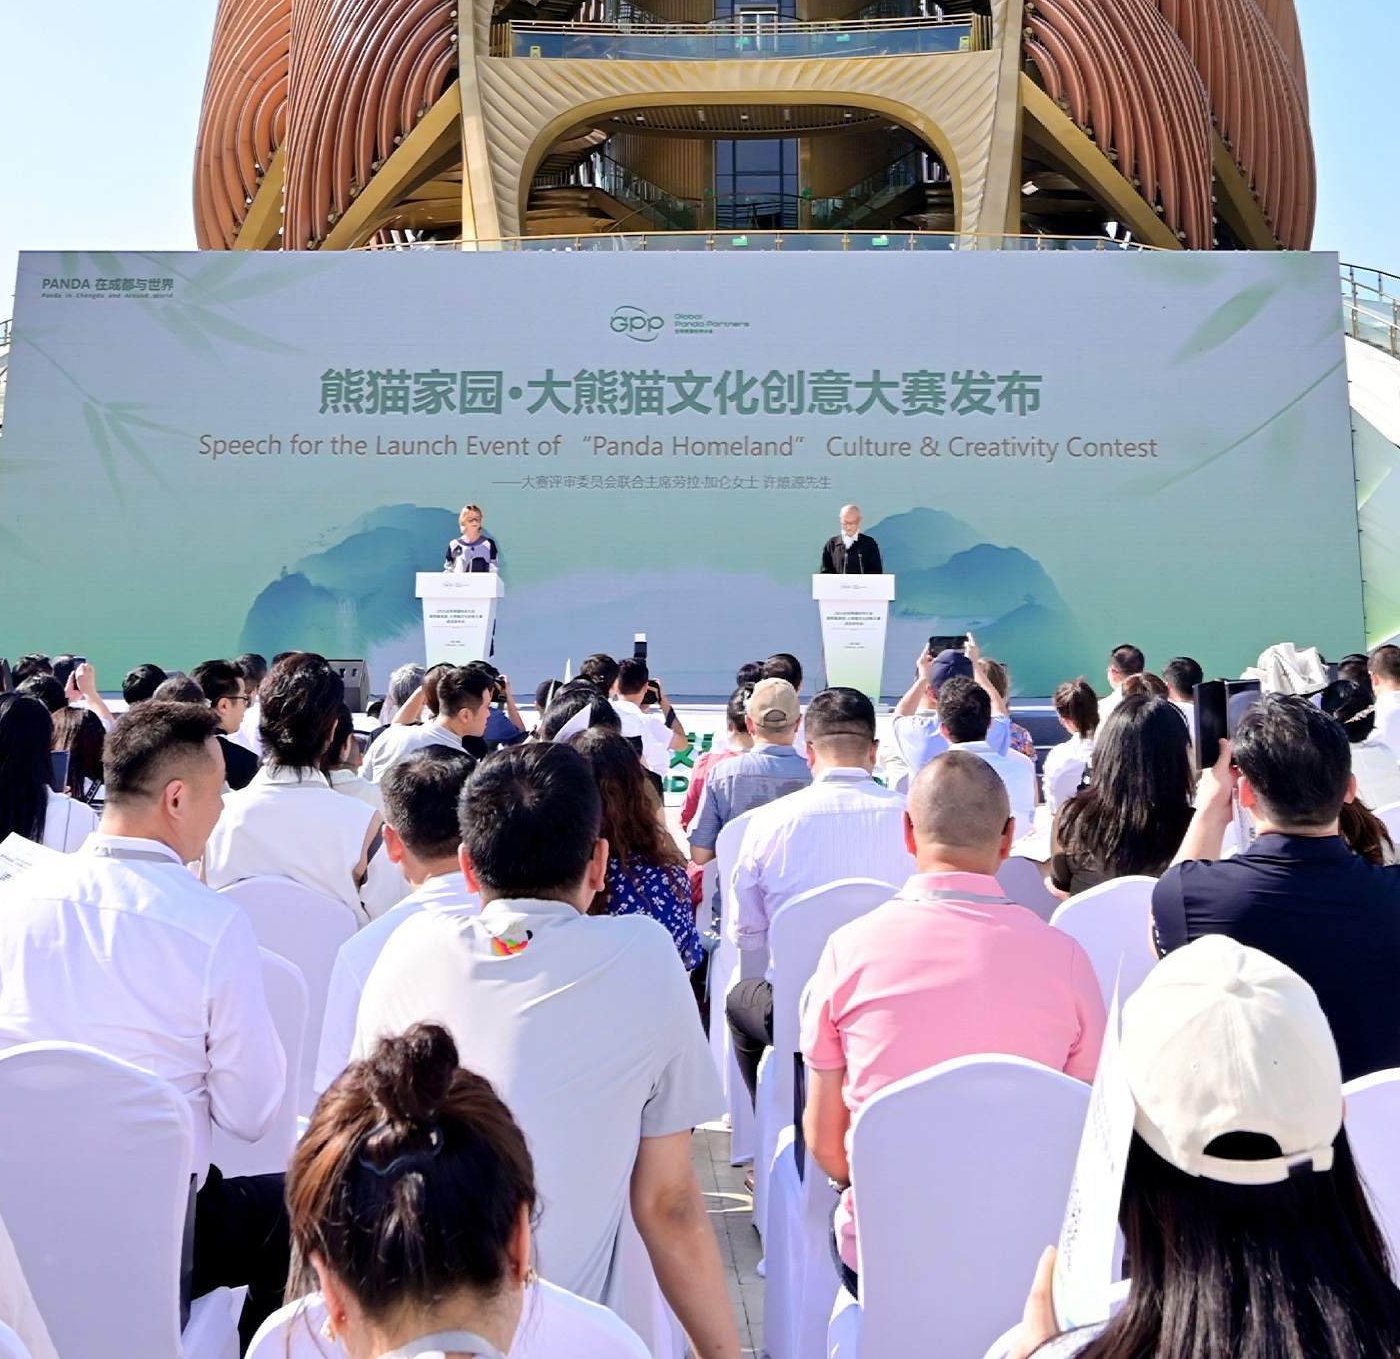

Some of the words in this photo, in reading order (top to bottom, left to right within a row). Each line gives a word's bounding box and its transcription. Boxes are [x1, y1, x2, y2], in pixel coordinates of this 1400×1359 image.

[41, 278, 90, 290] PANDA
[94, 277, 174, 291] 在成都与世界
[673, 320, 705, 328] Panda
[318, 367, 1043, 416] 熊猫家园·大熊猫文化创意大赛发布
[199, 433, 282, 461] Speech
[289, 433, 323, 455] for
[330, 433, 367, 455] the
[375, 433, 458, 455] Launch
[466, 435, 530, 455] Event
[536, 433, 563, 455] of
[582, 434, 664, 456] “Panda
[672, 434, 805, 456] Homeland”
[826, 435, 912, 457] Culture
[919, 435, 941, 457] &
[948, 435, 1060, 463] Creativity
[1066, 436, 1159, 457] Contest
